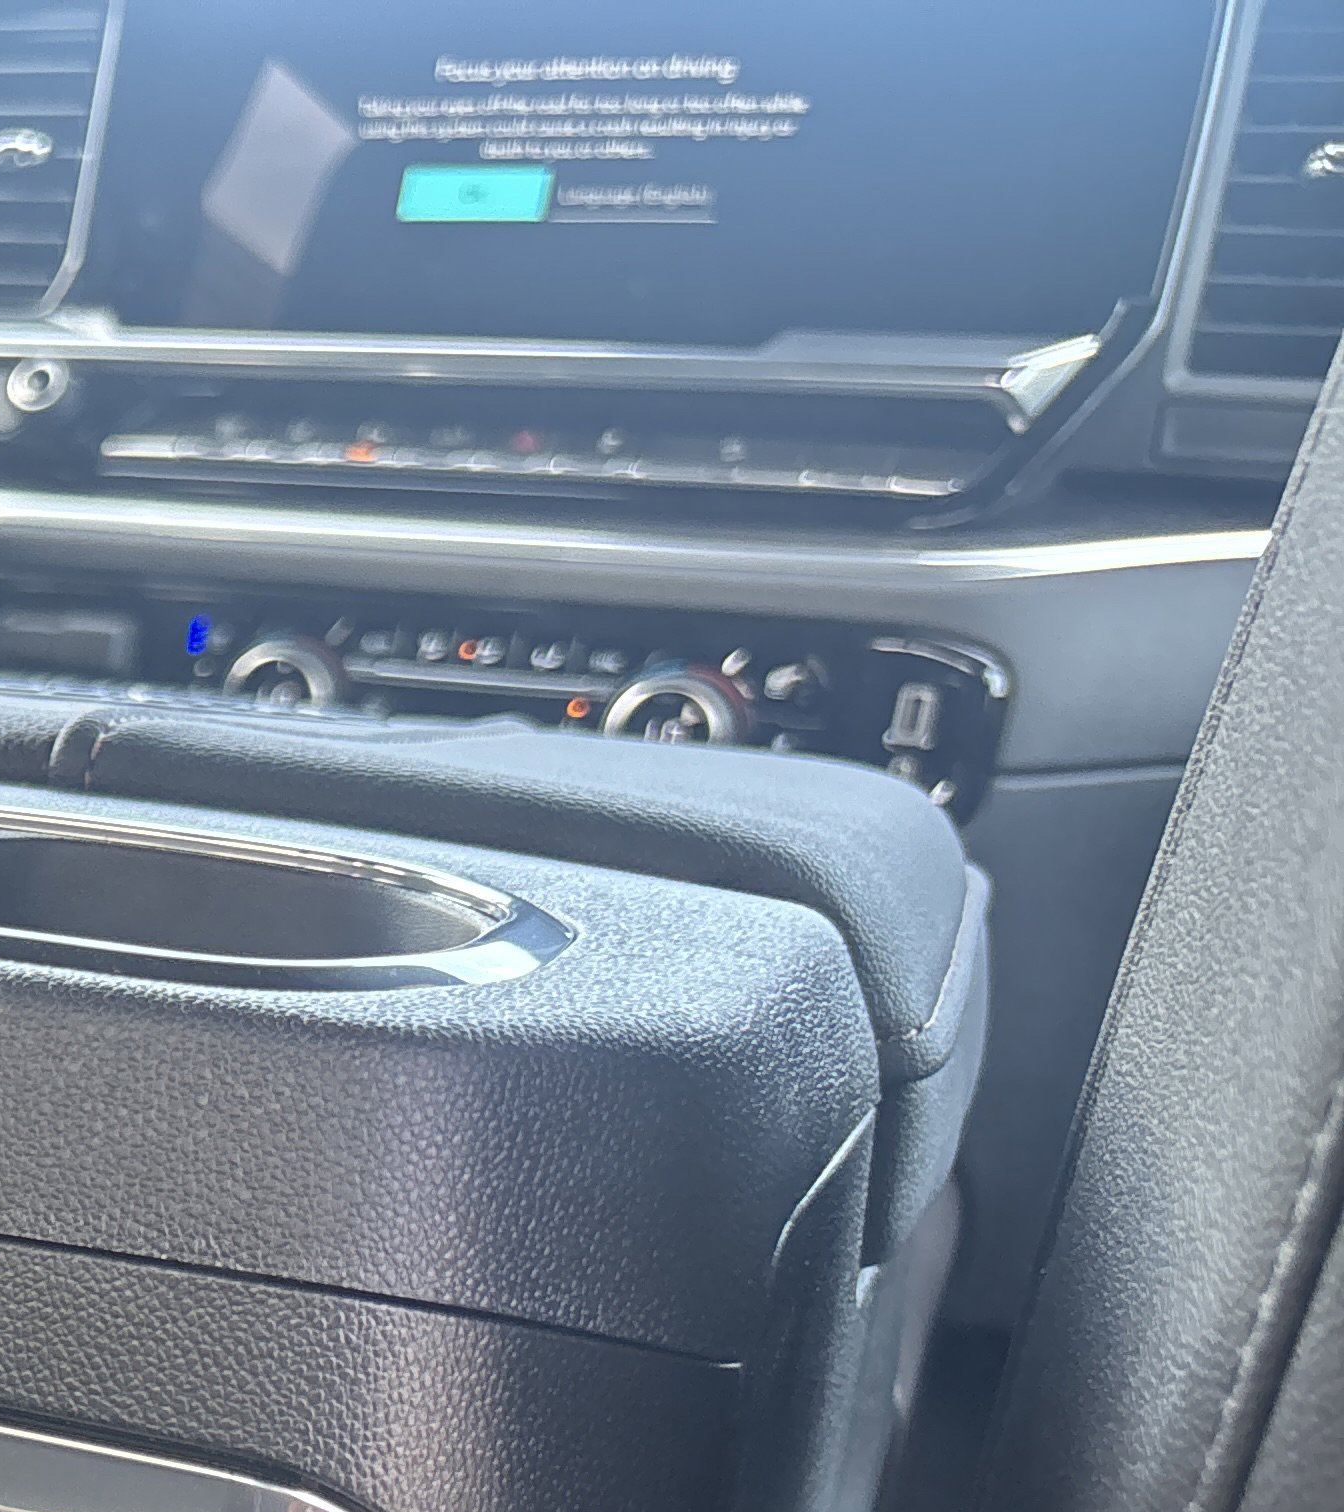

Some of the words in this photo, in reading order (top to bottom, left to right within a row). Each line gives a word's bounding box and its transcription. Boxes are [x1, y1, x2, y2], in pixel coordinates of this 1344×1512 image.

[435, 56, 495, 82] Focus
[495, 60, 539, 87] your
[540, 56, 633, 80] attention
[633, 59, 662, 79] on
[662, 54, 739, 84] driving
